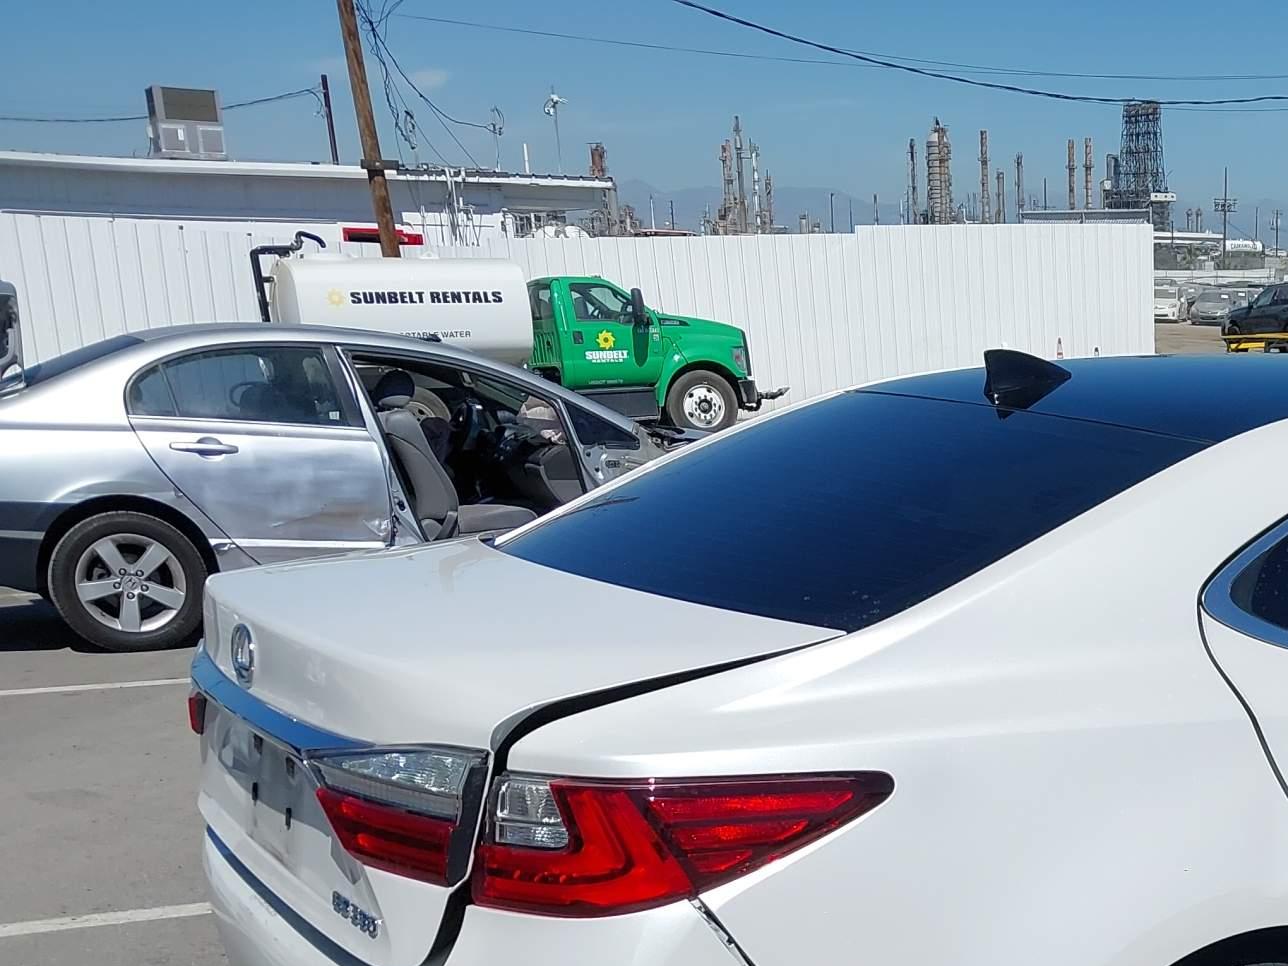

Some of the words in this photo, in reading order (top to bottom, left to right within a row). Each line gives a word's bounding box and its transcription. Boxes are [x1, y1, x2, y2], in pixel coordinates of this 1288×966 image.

[350, 291, 425, 304] SUNBELT
[430, 291, 503, 304] RENTALS
[441, 330, 471, 339] WATER
[584, 350, 629, 360] SUNBELT
